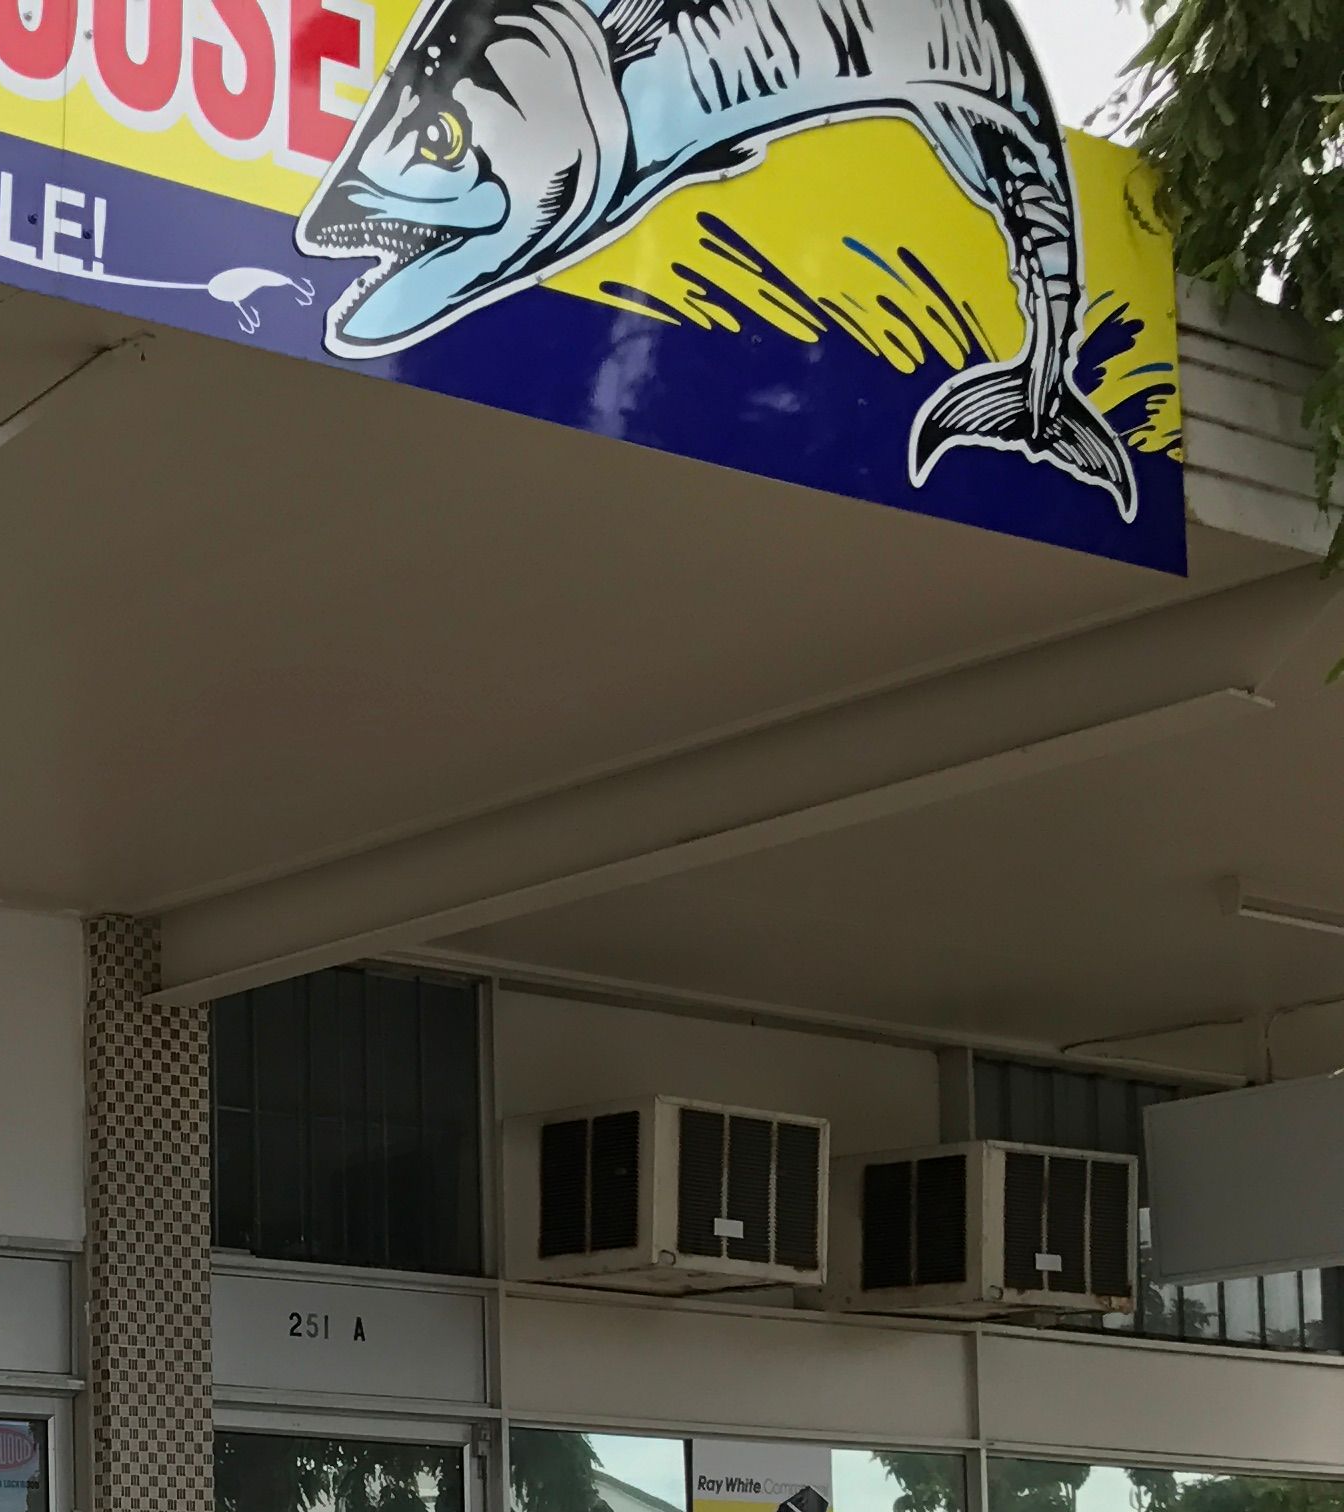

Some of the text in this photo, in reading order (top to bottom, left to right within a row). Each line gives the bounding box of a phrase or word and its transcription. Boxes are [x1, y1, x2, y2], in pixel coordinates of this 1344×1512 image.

[288, 1311, 367, 1342] 251 A
[697, 1474, 725, 1495] Ray
